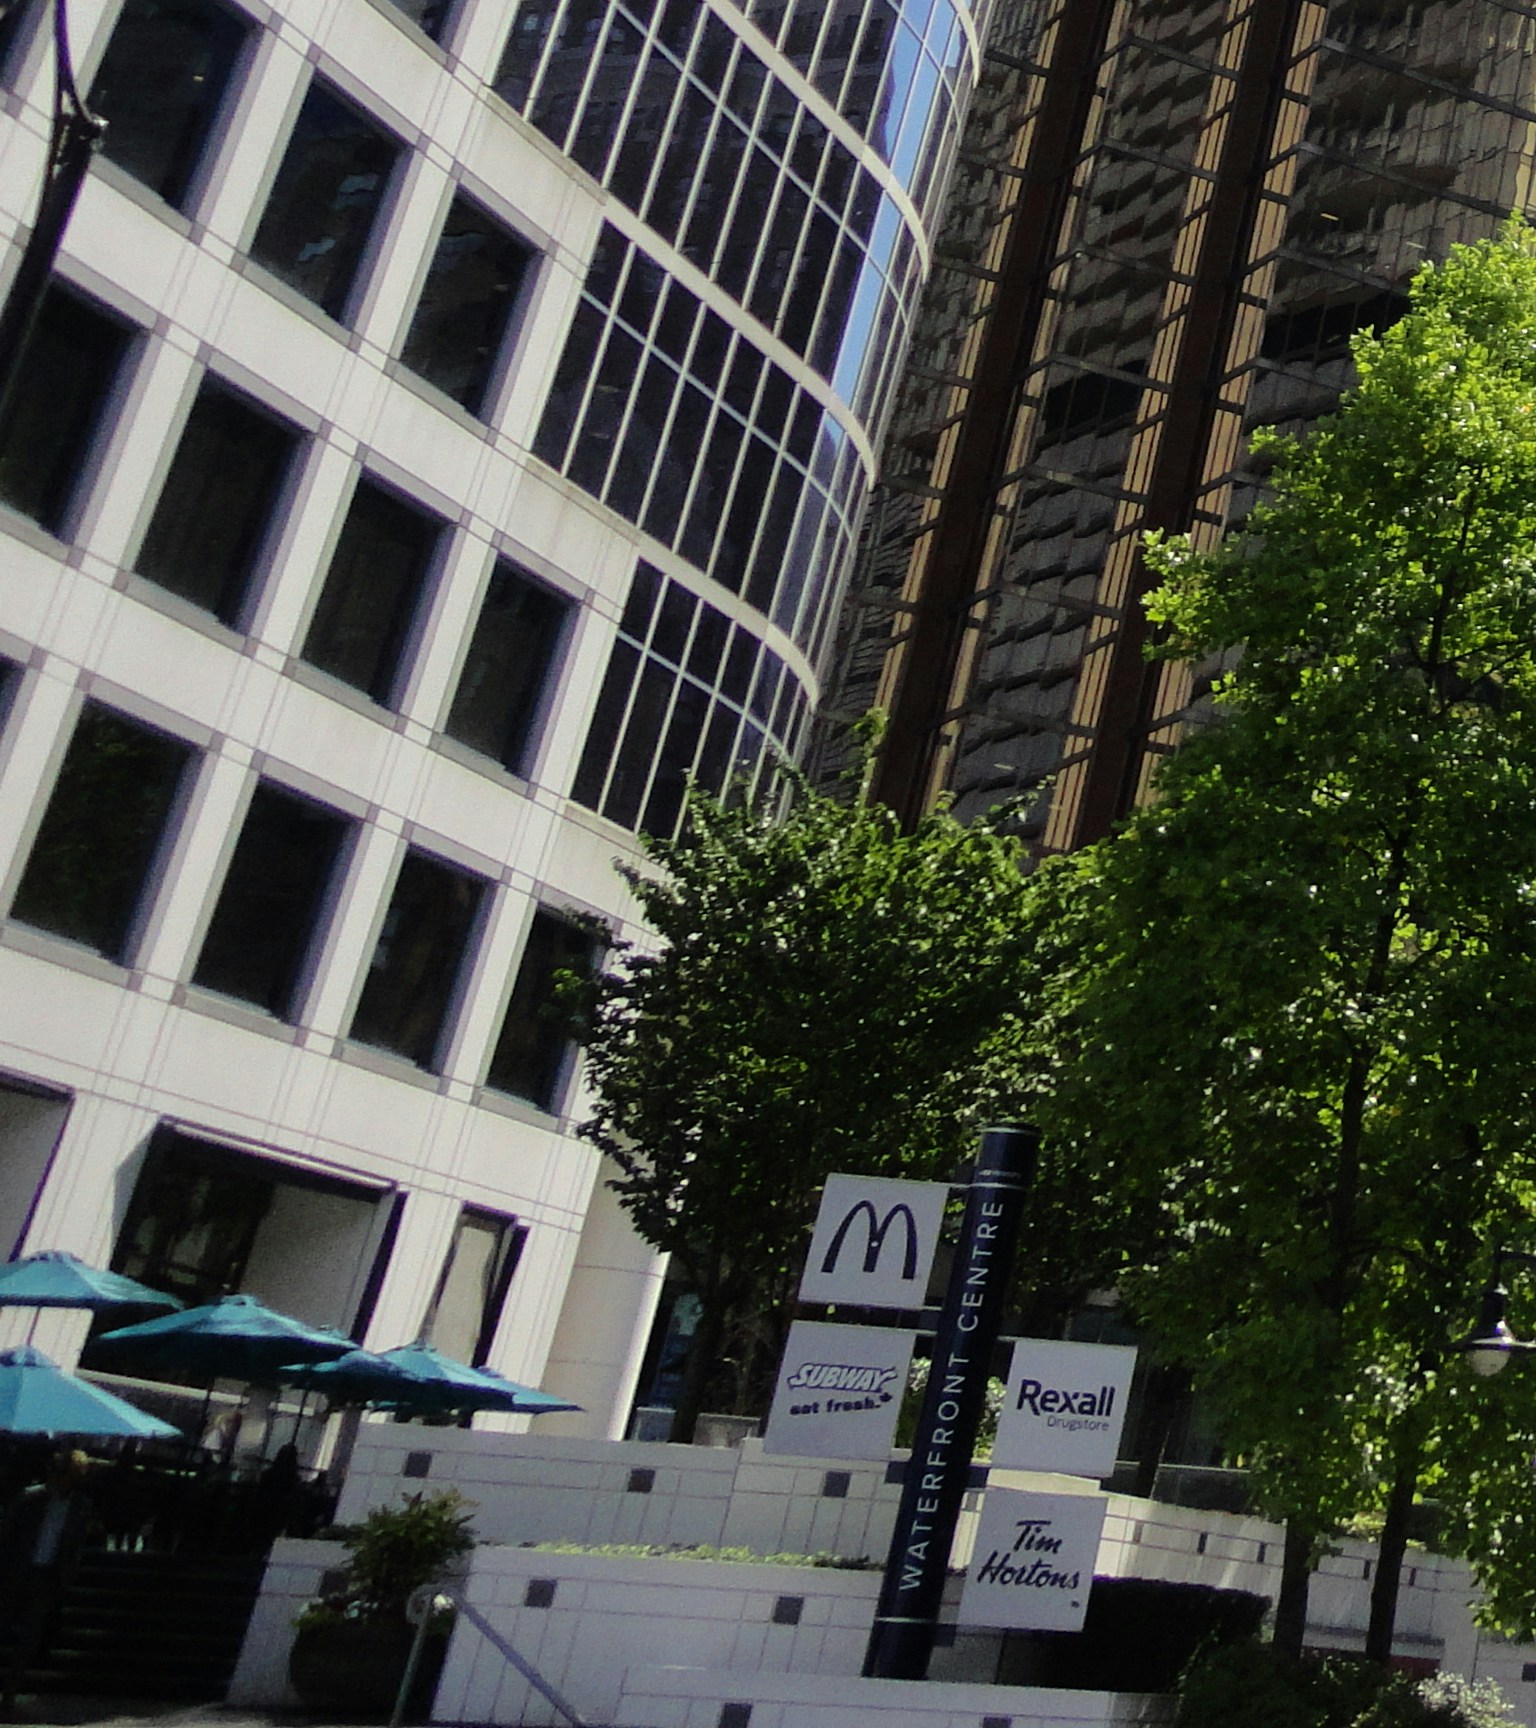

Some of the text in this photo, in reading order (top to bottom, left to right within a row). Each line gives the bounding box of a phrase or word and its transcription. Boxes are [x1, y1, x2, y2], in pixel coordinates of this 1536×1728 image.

[787, 1363, 897, 1392] SUBWAY
[899, 1352, 969, 1590] WATERFRONT
[957, 1201, 1003, 1332] CENTRE
[1016, 1378, 1115, 1417] Rexall
[1047, 1415, 1109, 1431] Drugstore
[1013, 1520, 1062, 1554] Tim
[977, 1550, 1079, 1590] Hortons
